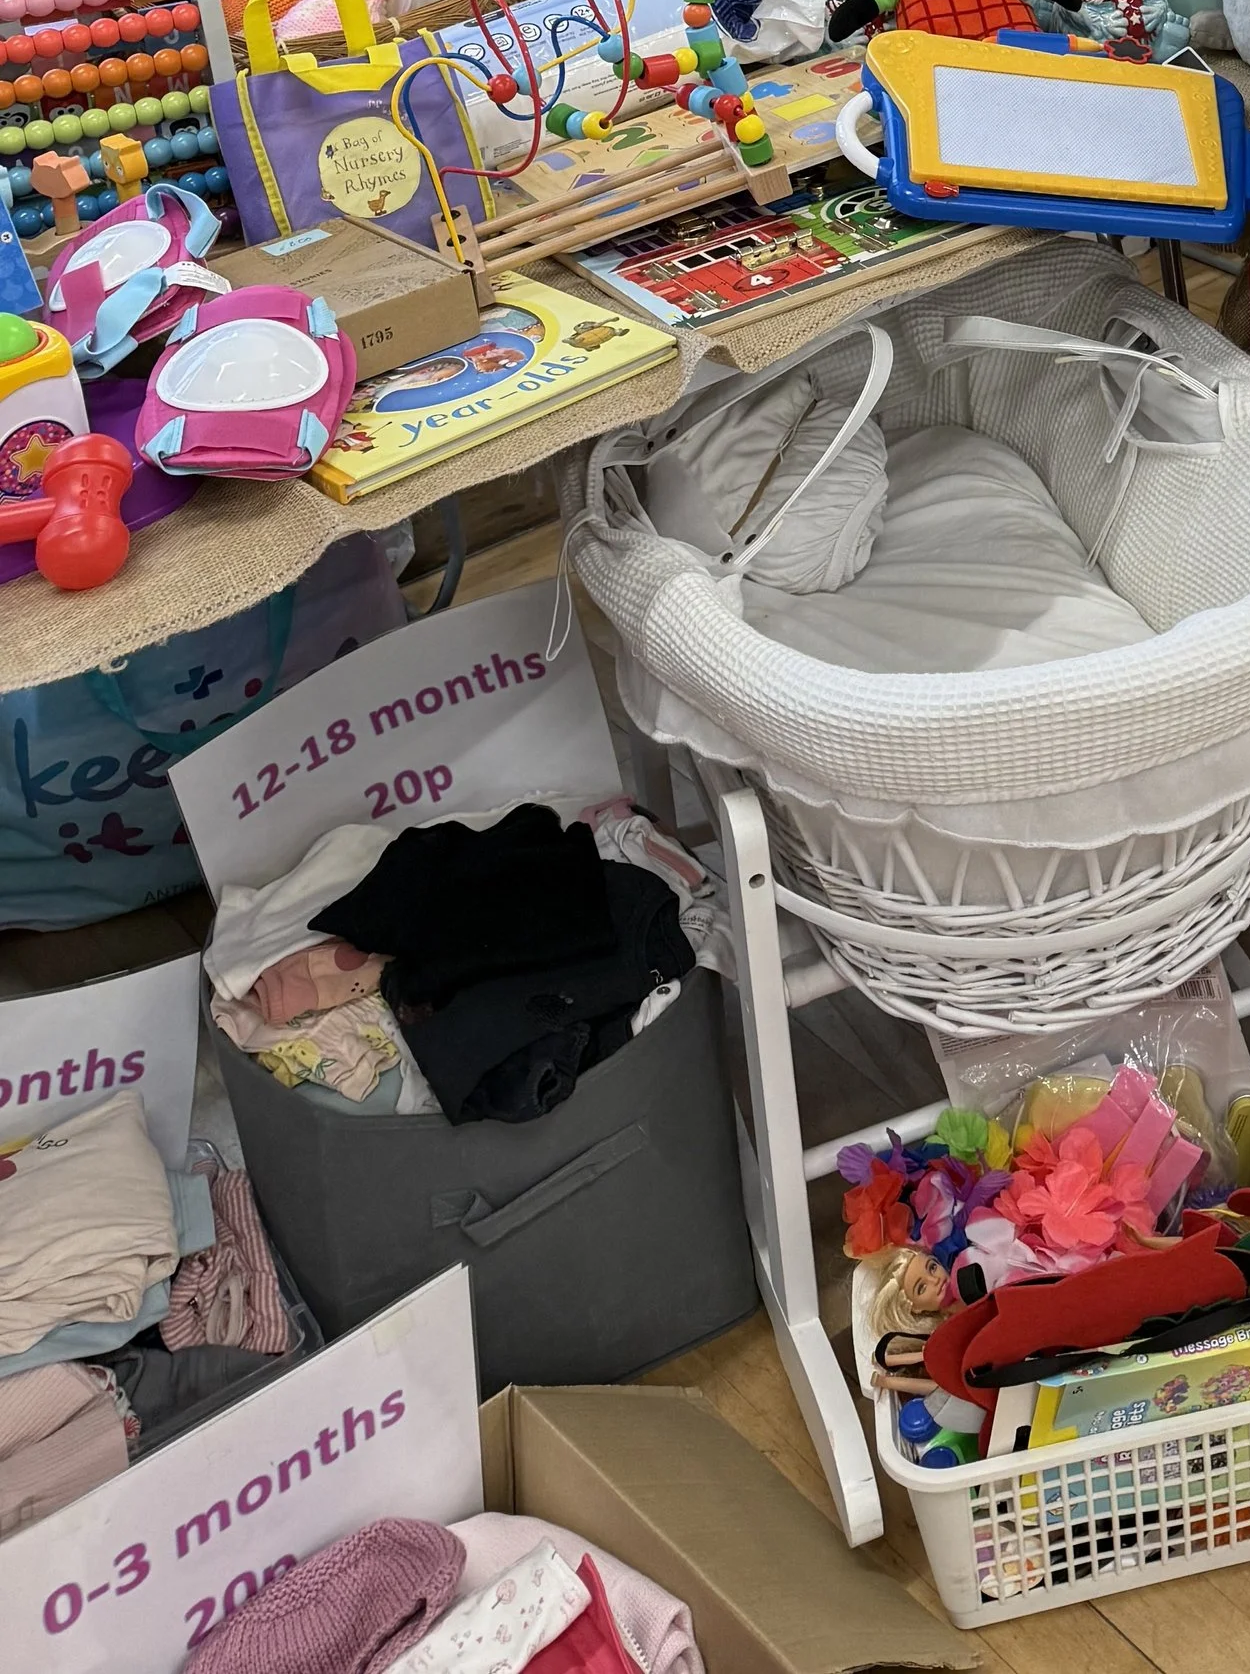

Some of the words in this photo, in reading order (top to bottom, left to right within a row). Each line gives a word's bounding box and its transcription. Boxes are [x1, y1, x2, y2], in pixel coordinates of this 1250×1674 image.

[334, 146, 404, 175] Nursery
[342, 137, 369, 151] Bag
[371, 129, 383, 143] of
[345, 169, 407, 194] Rhymes
[750, 275, 774, 286] 4
[360, 327, 395, 350] 1795
[398, 355, 589, 448] year-olds
[232, 719, 356, 820] 12-18
[369, 652, 546, 736] months
[14, 717, 174, 818] kee
[364, 763, 453, 820] 20p
[42, 1542, 151, 1635] 0-3
[175, 1389, 406, 1560] months
